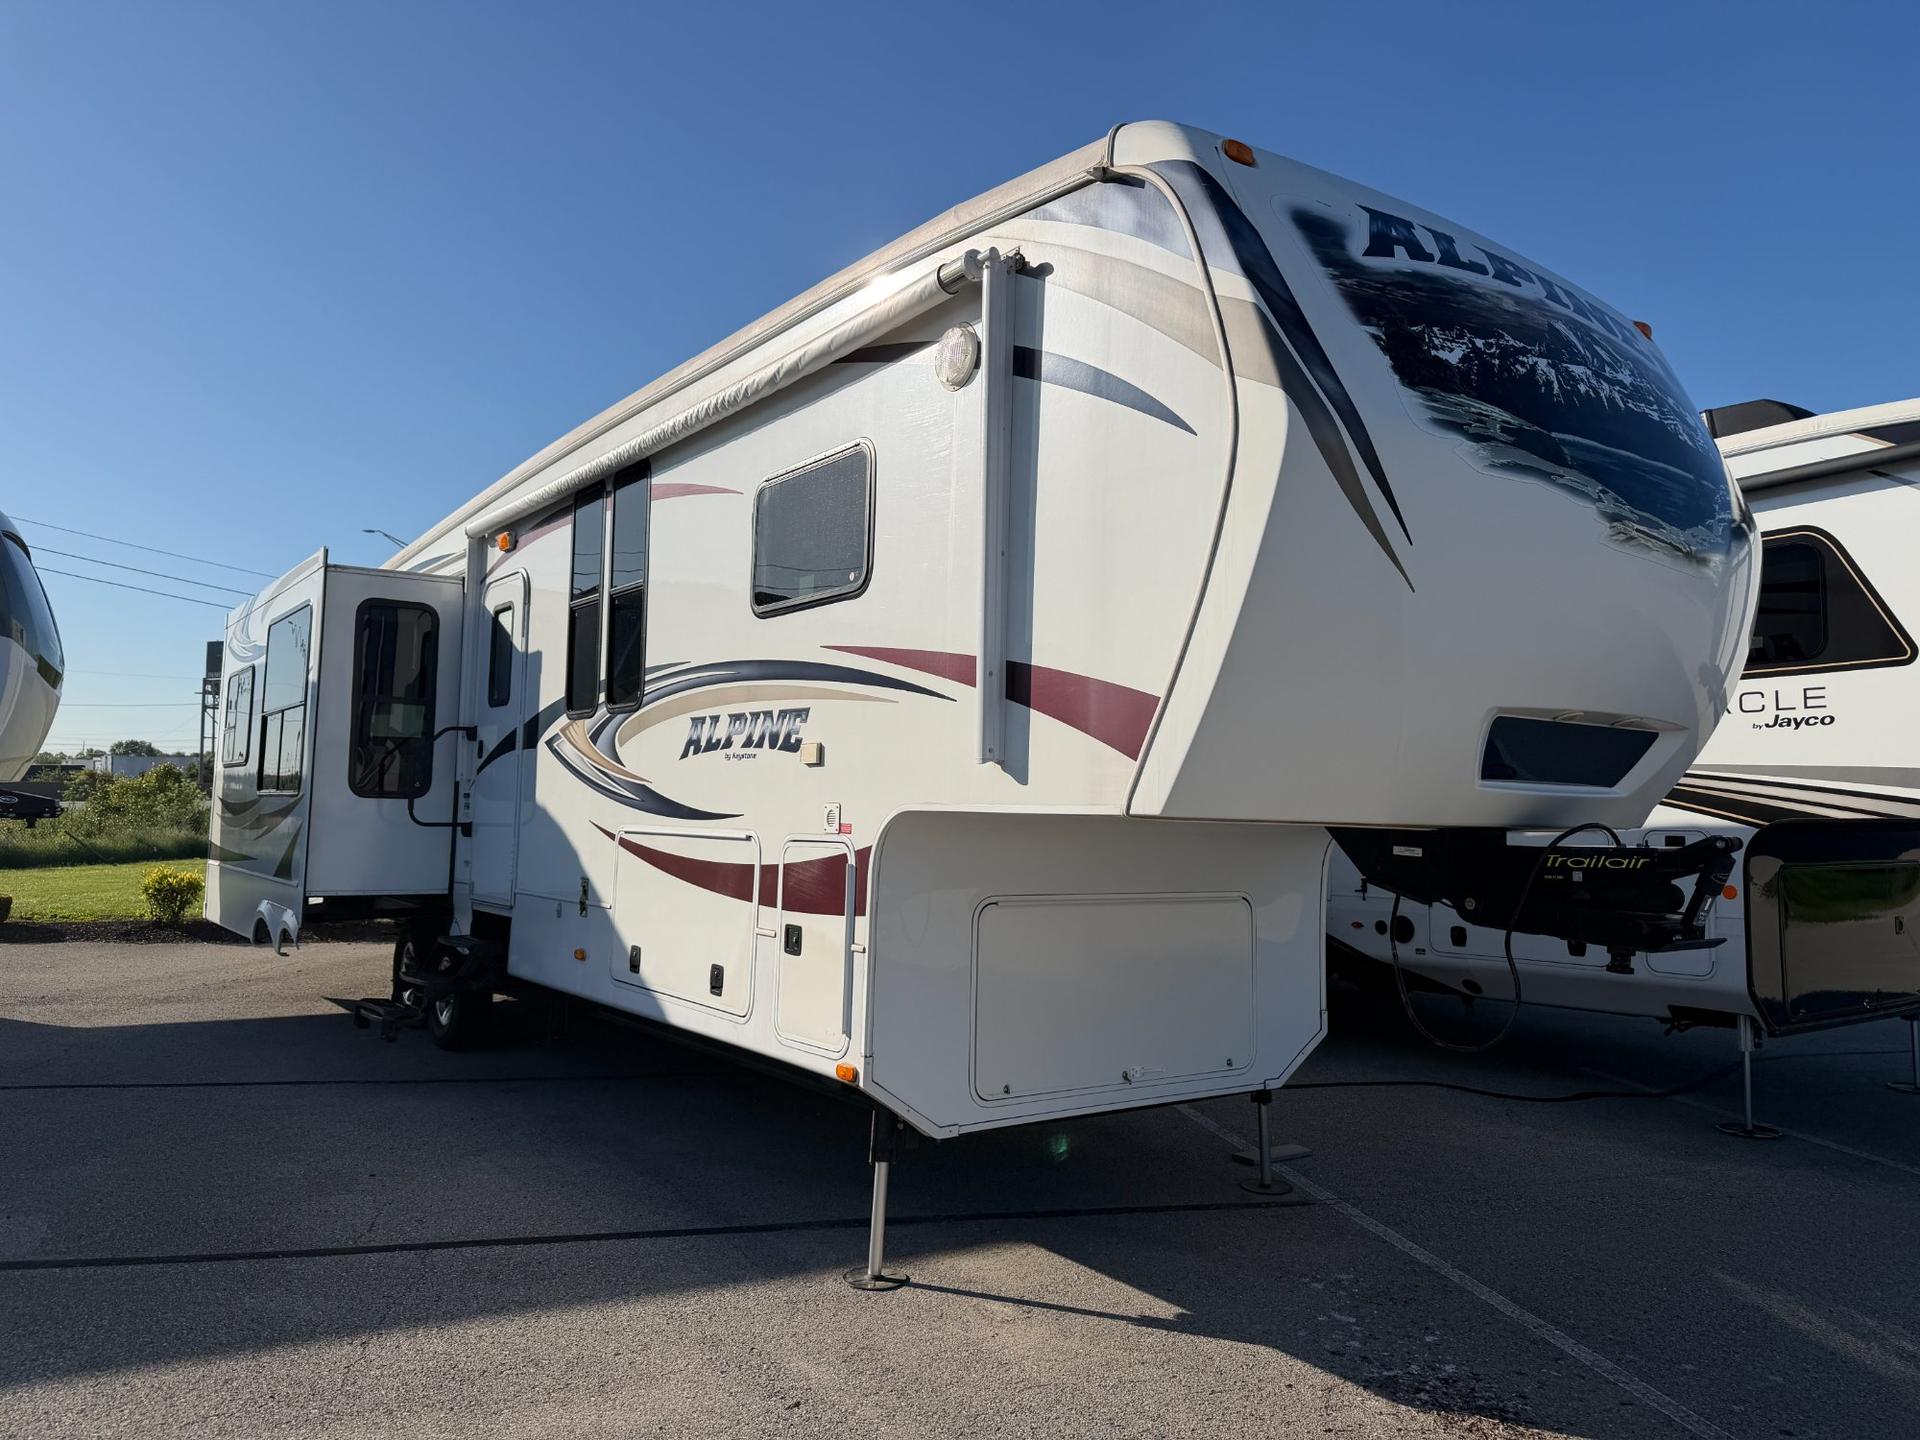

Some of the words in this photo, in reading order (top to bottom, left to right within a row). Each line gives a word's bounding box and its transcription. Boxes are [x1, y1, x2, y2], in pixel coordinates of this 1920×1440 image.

[1725, 686, 1828, 714] CLE
[1764, 714, 1836, 731] Jayco
[679, 707, 811, 761] ALPINE
[724, 752, 732, 761] by
[1546, 854, 1651, 869] Trailair
